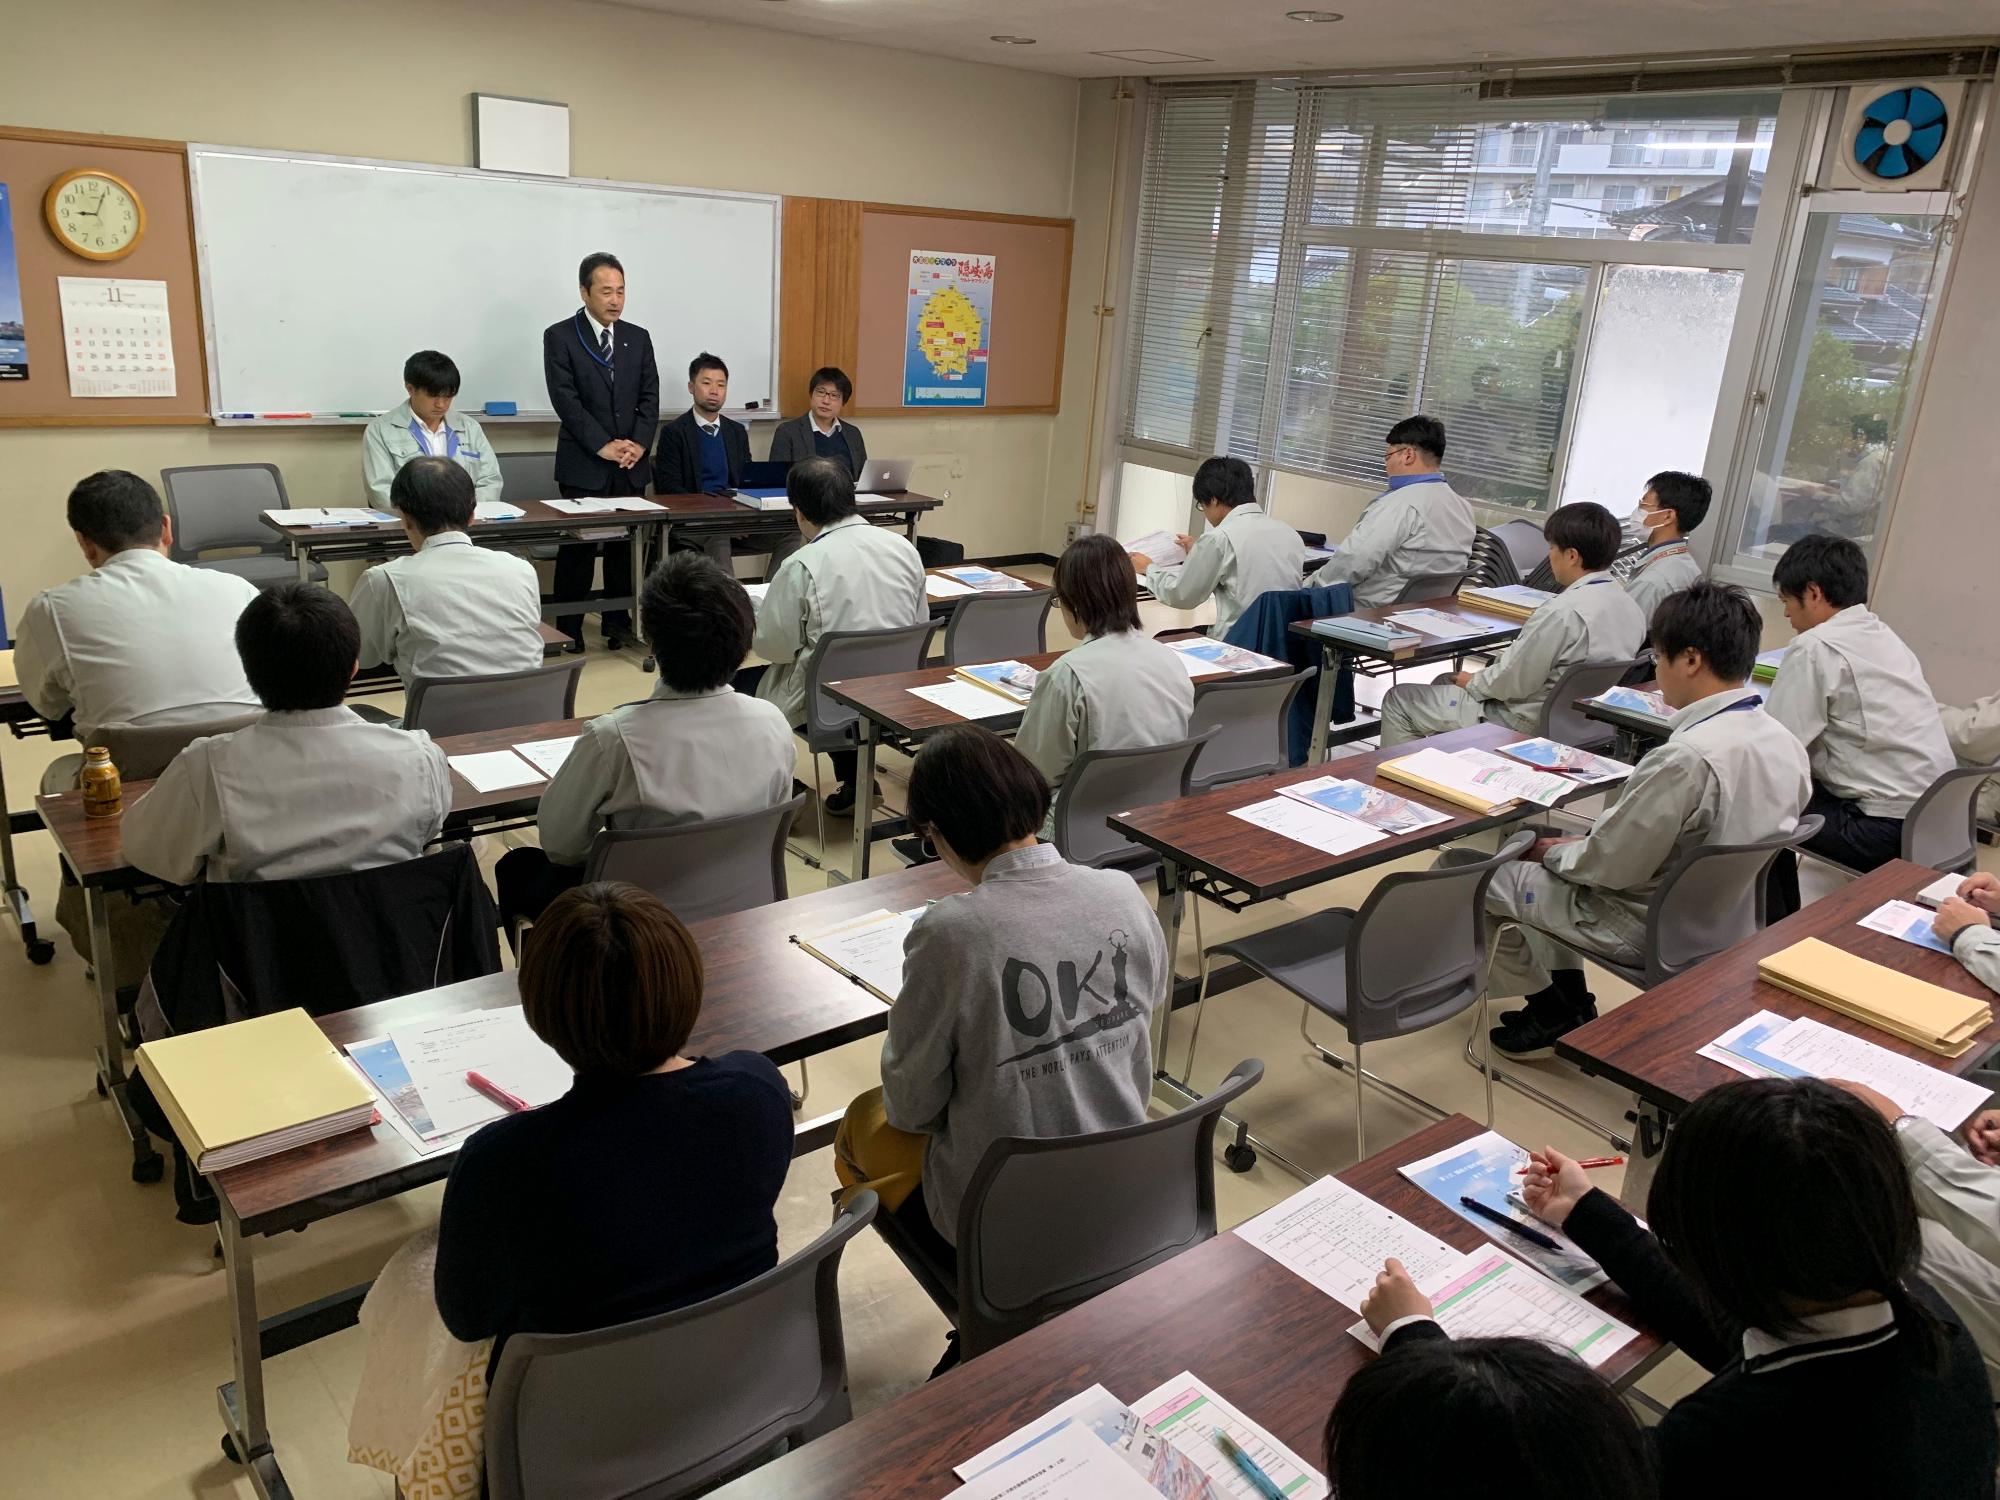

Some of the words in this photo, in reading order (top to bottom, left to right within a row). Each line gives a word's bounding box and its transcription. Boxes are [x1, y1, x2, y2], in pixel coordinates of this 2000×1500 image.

[73, 183, 84, 194] 11
[88, 181, 98, 191] 12
[105, 185, 111, 196] 1
[64, 194, 75, 204] 10
[116, 195, 124, 206] 2
[61, 207, 70, 218] 9
[123, 209, 131, 220] 3
[68, 222, 77, 233] 8
[81, 232, 88, 243] 7
[95, 237, 104, 247] 6
[111, 233, 118, 244] 5
[107, 287, 123, 302] 11
[1001, 948, 1129, 1037] OKI
[1020, 1067, 1036, 1080] THE
[1041, 1061, 1066, 1075] WORL
[1070, 1050, 1090, 1064] PAYS
[1096, 1035, 1130, 1059] ATTENTION
